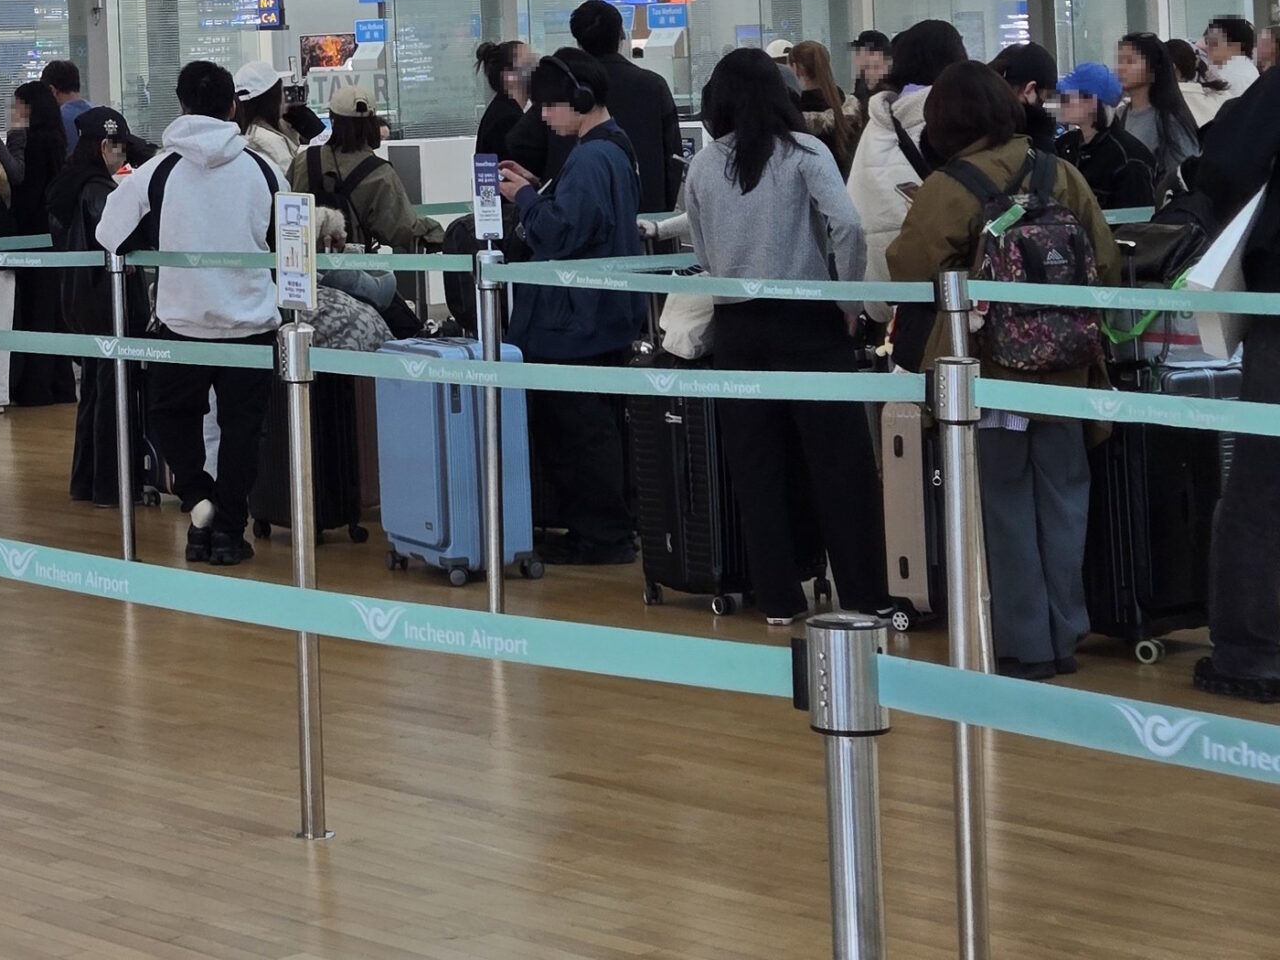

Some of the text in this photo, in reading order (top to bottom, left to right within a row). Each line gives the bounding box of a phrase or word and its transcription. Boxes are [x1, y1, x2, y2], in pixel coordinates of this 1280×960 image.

[576, 276, 628, 288] Incheon Airport
[763, 286, 823, 297] Incheon Airport
[118, 345, 171, 360] Incheon Airport
[428, 367, 498, 384] Incheon Airport
[679, 380, 761, 395] Incheon Airport
[34, 559, 129, 595] Incheon Airport
[403, 619, 528, 657] Incheon Airport
